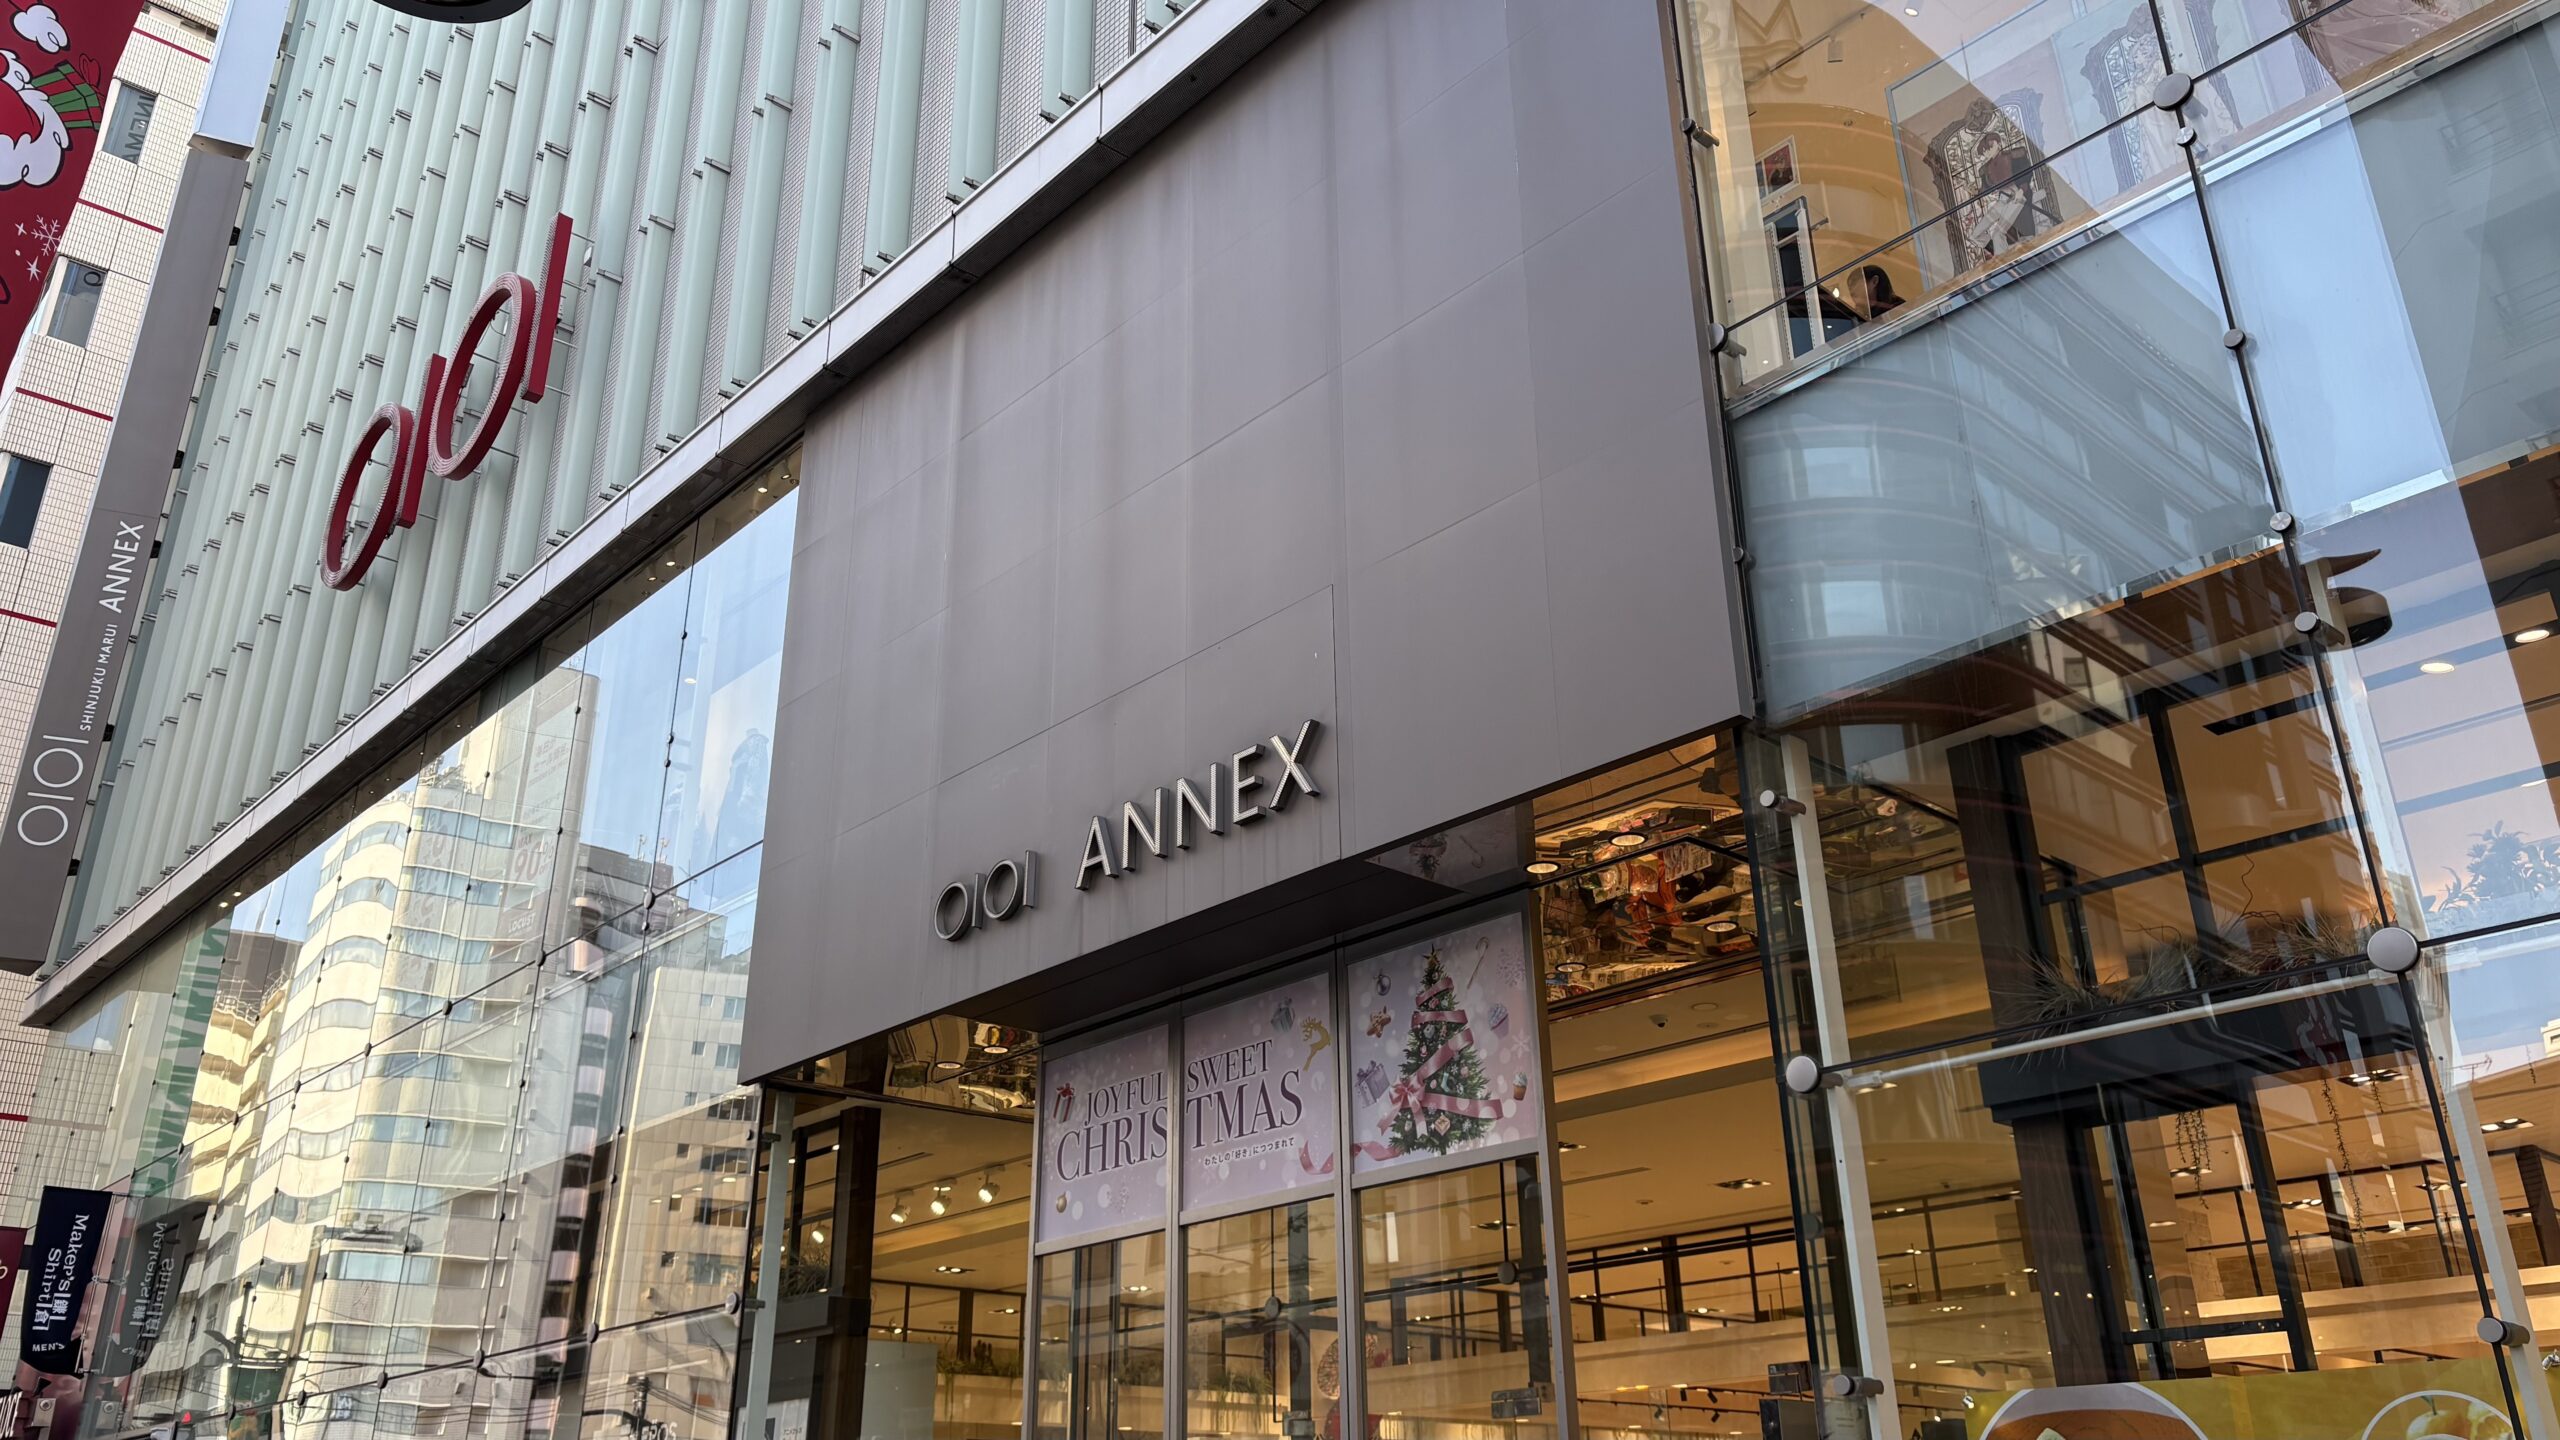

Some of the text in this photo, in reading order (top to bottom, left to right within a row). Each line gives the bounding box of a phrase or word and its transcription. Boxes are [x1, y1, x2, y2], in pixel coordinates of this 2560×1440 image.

[99, 520, 145, 613] ANNEX
[97, 622, 118, 664] MARUI
[79, 666, 106, 732] SHINJUKU
[1075, 719, 1321, 891] ANNEX
[1084, 1040, 1272, 1125] JOYFUL SWEET
[1203, 1136, 1295, 1167] わたしの「好き」につつまれて
[38, 1248, 62, 1301] Shirt
[59, 1214, 90, 1291] Maker's
